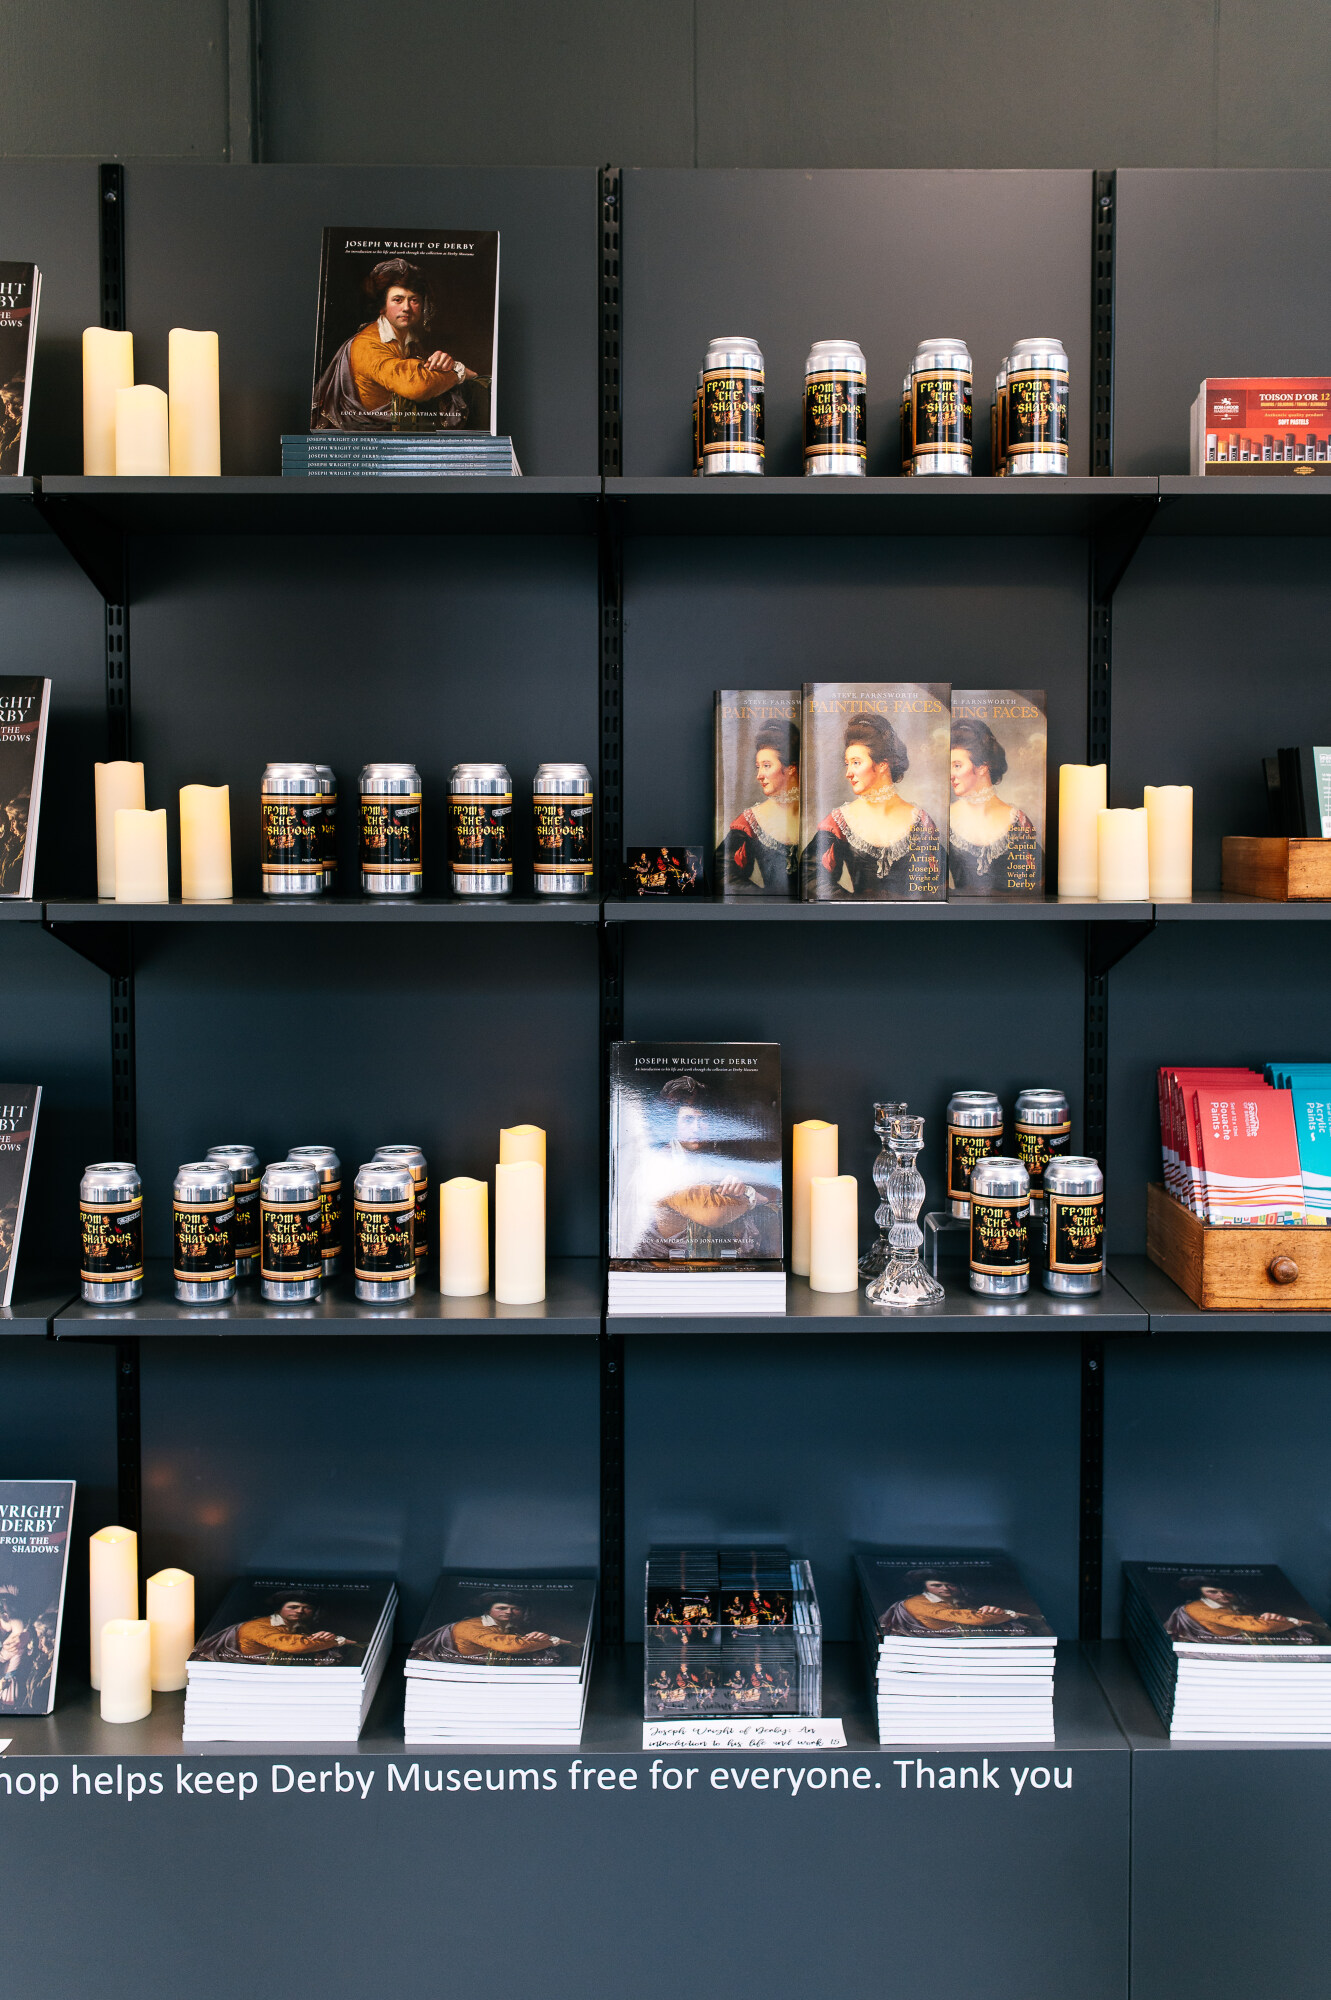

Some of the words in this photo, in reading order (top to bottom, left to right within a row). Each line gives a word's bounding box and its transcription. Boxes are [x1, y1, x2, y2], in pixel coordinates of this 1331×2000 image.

[344, 240, 381, 249] JOSEPH
[384, 241, 425, 249] WRIGHT
[707, 381, 735, 392] FROM
[807, 383, 834, 395] FROM
[920, 381, 951, 394] FROM
[1012, 381, 1043, 394] FROM
[718, 391, 740, 400] THE
[818, 393, 839, 403] THE
[935, 392, 957, 402] THE
[1024, 391, 1048, 401] THE
[1260, 393, 1294, 401] TOISON
[1295, 393, 1318, 401] D'OR
[1320, 392, 1330, 400] 12
[712, 403, 760, 412] SHADOWS
[812, 404, 861, 415] SHADOWS
[927, 402, 972, 414] SHADOWS
[1018, 403, 1066, 413] SHADOWS
[0, 697, 36, 709] GHT
[808, 701, 888, 713] PAINTING
[894, 700, 942, 713] FACES
[0, 710, 28, 722] RBY
[721, 706, 796, 719] PAINTING
[951, 706, 988, 719] TING
[992, 706, 1039, 719] FACES
[263, 806, 288, 815] FROM
[453, 806, 478, 815] FROM
[534, 806, 557, 815] FROM
[273, 816, 294, 826] THE
[367, 816, 386, 826] THE
[462, 816, 481, 826] THE
[541, 816, 561, 826] THE
[267, 825, 316, 836] SHADOWS
[363, 825, 409, 836] SHADOWS
[457, 825, 505, 836] SHADOWS
[537, 825, 584, 836] SHADOWS
[909, 825, 932, 834] Being
[1008, 825, 1030, 834] Being
[909, 843, 939, 853] Capital
[1007, 842, 1036, 852] Capital
[909, 854, 938, 863] Artist,
[1007, 852, 1035, 861] Artist,
[908, 865, 938, 874] Joseph
[1006, 862, 1035, 871] Joseph
[909, 883, 938, 894] Derby
[1007, 880, 1035, 890] Derby
[634, 1057, 668, 1065] JOSEPH
[1210, 1102, 1221, 1130] Paints
[1220, 1101, 1231, 1140] Gouache
[1247, 1102, 1258, 1137] seawhite
[1306, 1102, 1316, 1130] Paints
[1315, 1102, 1327, 1133] Acrylic
[956, 1137, 984, 1147] FROM
[968, 1148, 988, 1156] THE
[1022, 1144, 1041, 1154] THE
[356, 1212, 381, 1222] FROM
[975, 1206, 1004, 1218] FROM
[1061, 1207, 1092, 1217] FROM
[175, 1213, 200, 1223] FROM
[265, 1212, 293, 1223] FROM
[1076, 1216, 1096, 1226] THE
[277, 1223, 299, 1233] THE
[366, 1223, 386, 1233] THE
[987, 1218, 1008, 1228] THE
[87, 1224, 106, 1234] THE
[184, 1224, 205, 1234] THE
[980, 1226, 1027, 1238] SHADOWS
[82, 1232, 131, 1244] SHADOWS
[179, 1232, 228, 1244] SHADOWS
[271, 1231, 318, 1243] SHADOWS
[360, 1231, 409, 1243] SHADOWS
[1, 1519, 56, 1532] DERBY
[0, 1536, 27, 1545] FROM
[30, 1537, 49, 1545] THE
[12, 1545, 60, 1553] SHADOWS
[650, 1726, 686, 1735] Joseph
[693, 1726, 734, 1735] Wright
[739, 1726, 750, 1735] of
[712, 1739, 720, 1747] to
[727, 1739, 742, 1747] his
[749, 1738, 766, 1747] life
[797, 1738, 823, 1747] work
[0, 1773, 59, 1802] op
[72, 1764, 164, 1802] helps
[176, 1763, 259, 1800] keep
[272, 1762, 374, 1799] Derby
[387, 1763, 557, 1792] Museums
[568, 1760, 637, 1790] free
[648, 1760, 700, 1790] for
[709, 1765, 881, 1796] everyone.
[894, 1759, 1000, 1790] Thank
[1010, 1766, 1074, 1796] you
